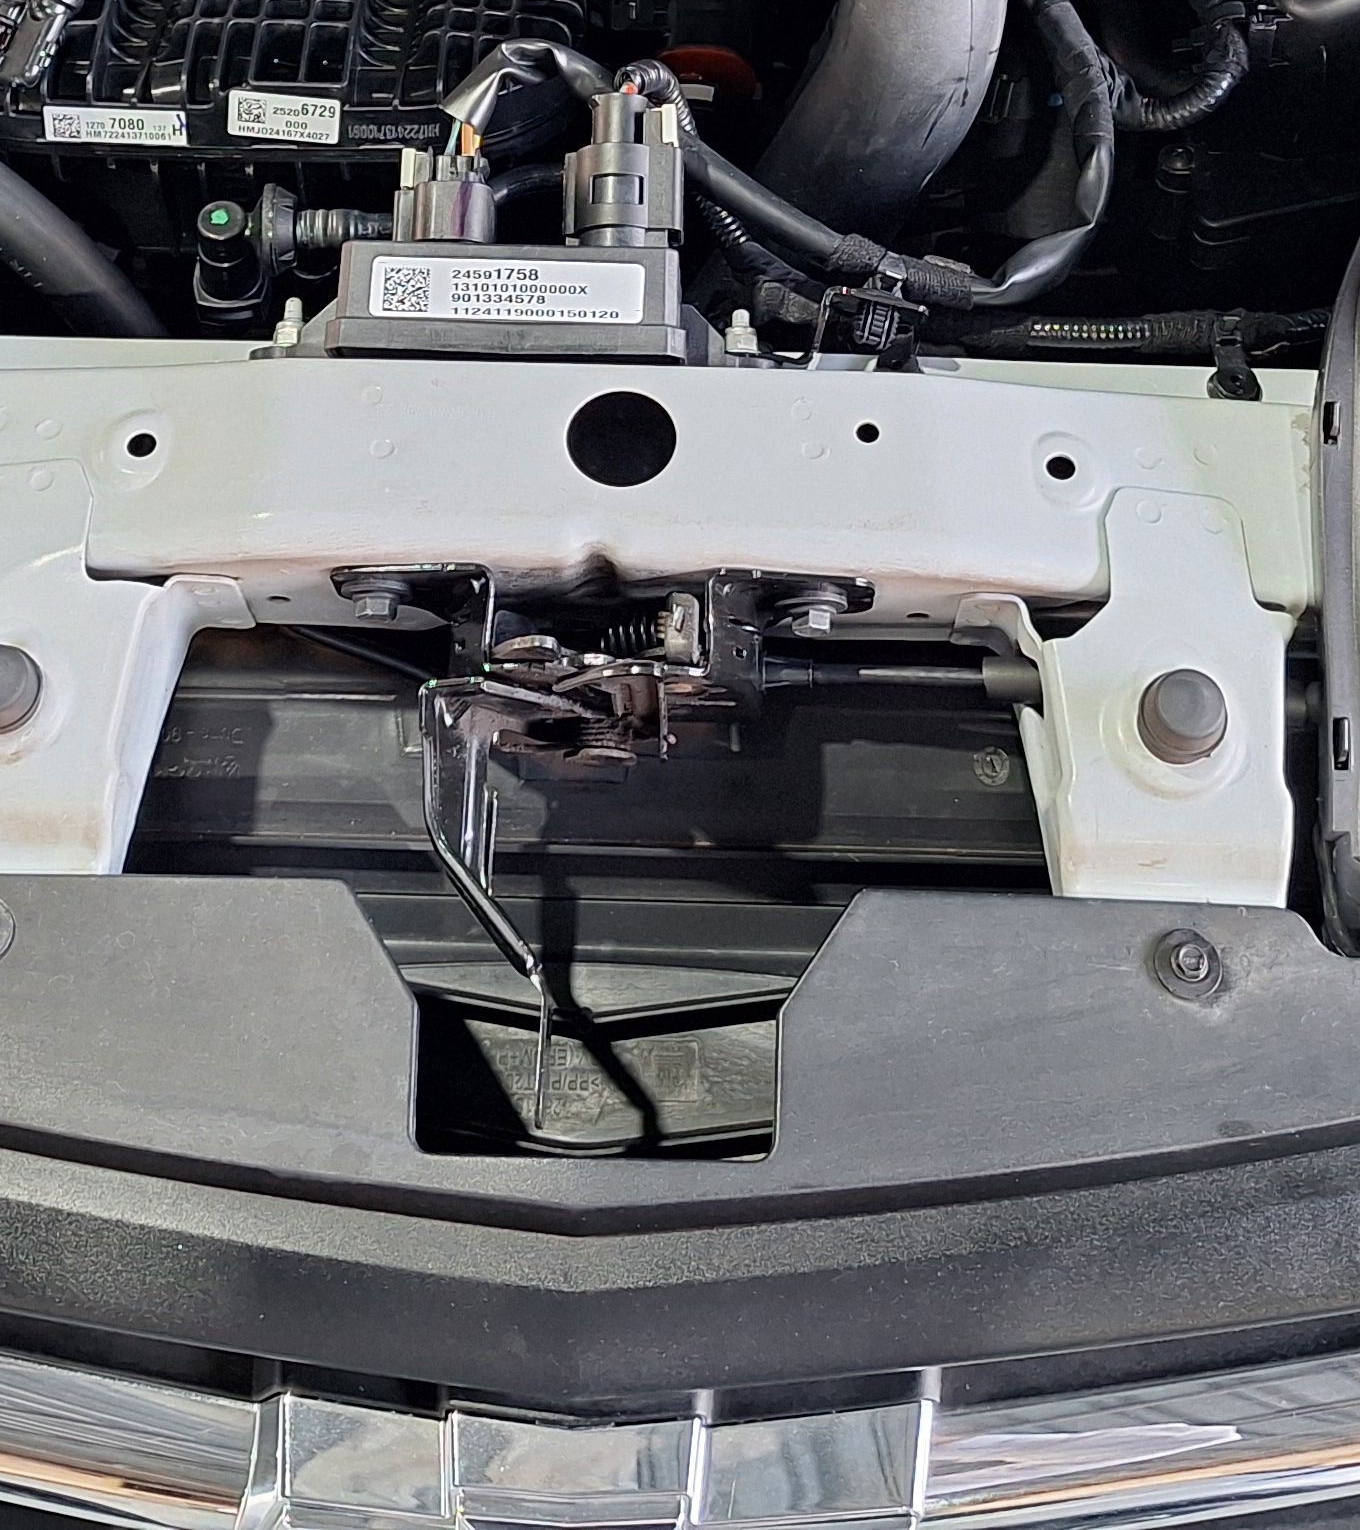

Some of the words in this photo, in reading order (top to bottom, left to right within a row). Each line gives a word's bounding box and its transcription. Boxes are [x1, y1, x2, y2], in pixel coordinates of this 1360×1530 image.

[272, 102, 336, 119] 25206729
[285, 120, 308, 131] 000
[451, 268, 539, 281] 24591758
[451, 282, 589, 295] 1310101000000X
[450, 293, 547, 305] 901334578
[450, 307, 620, 319] 1124119000150120
